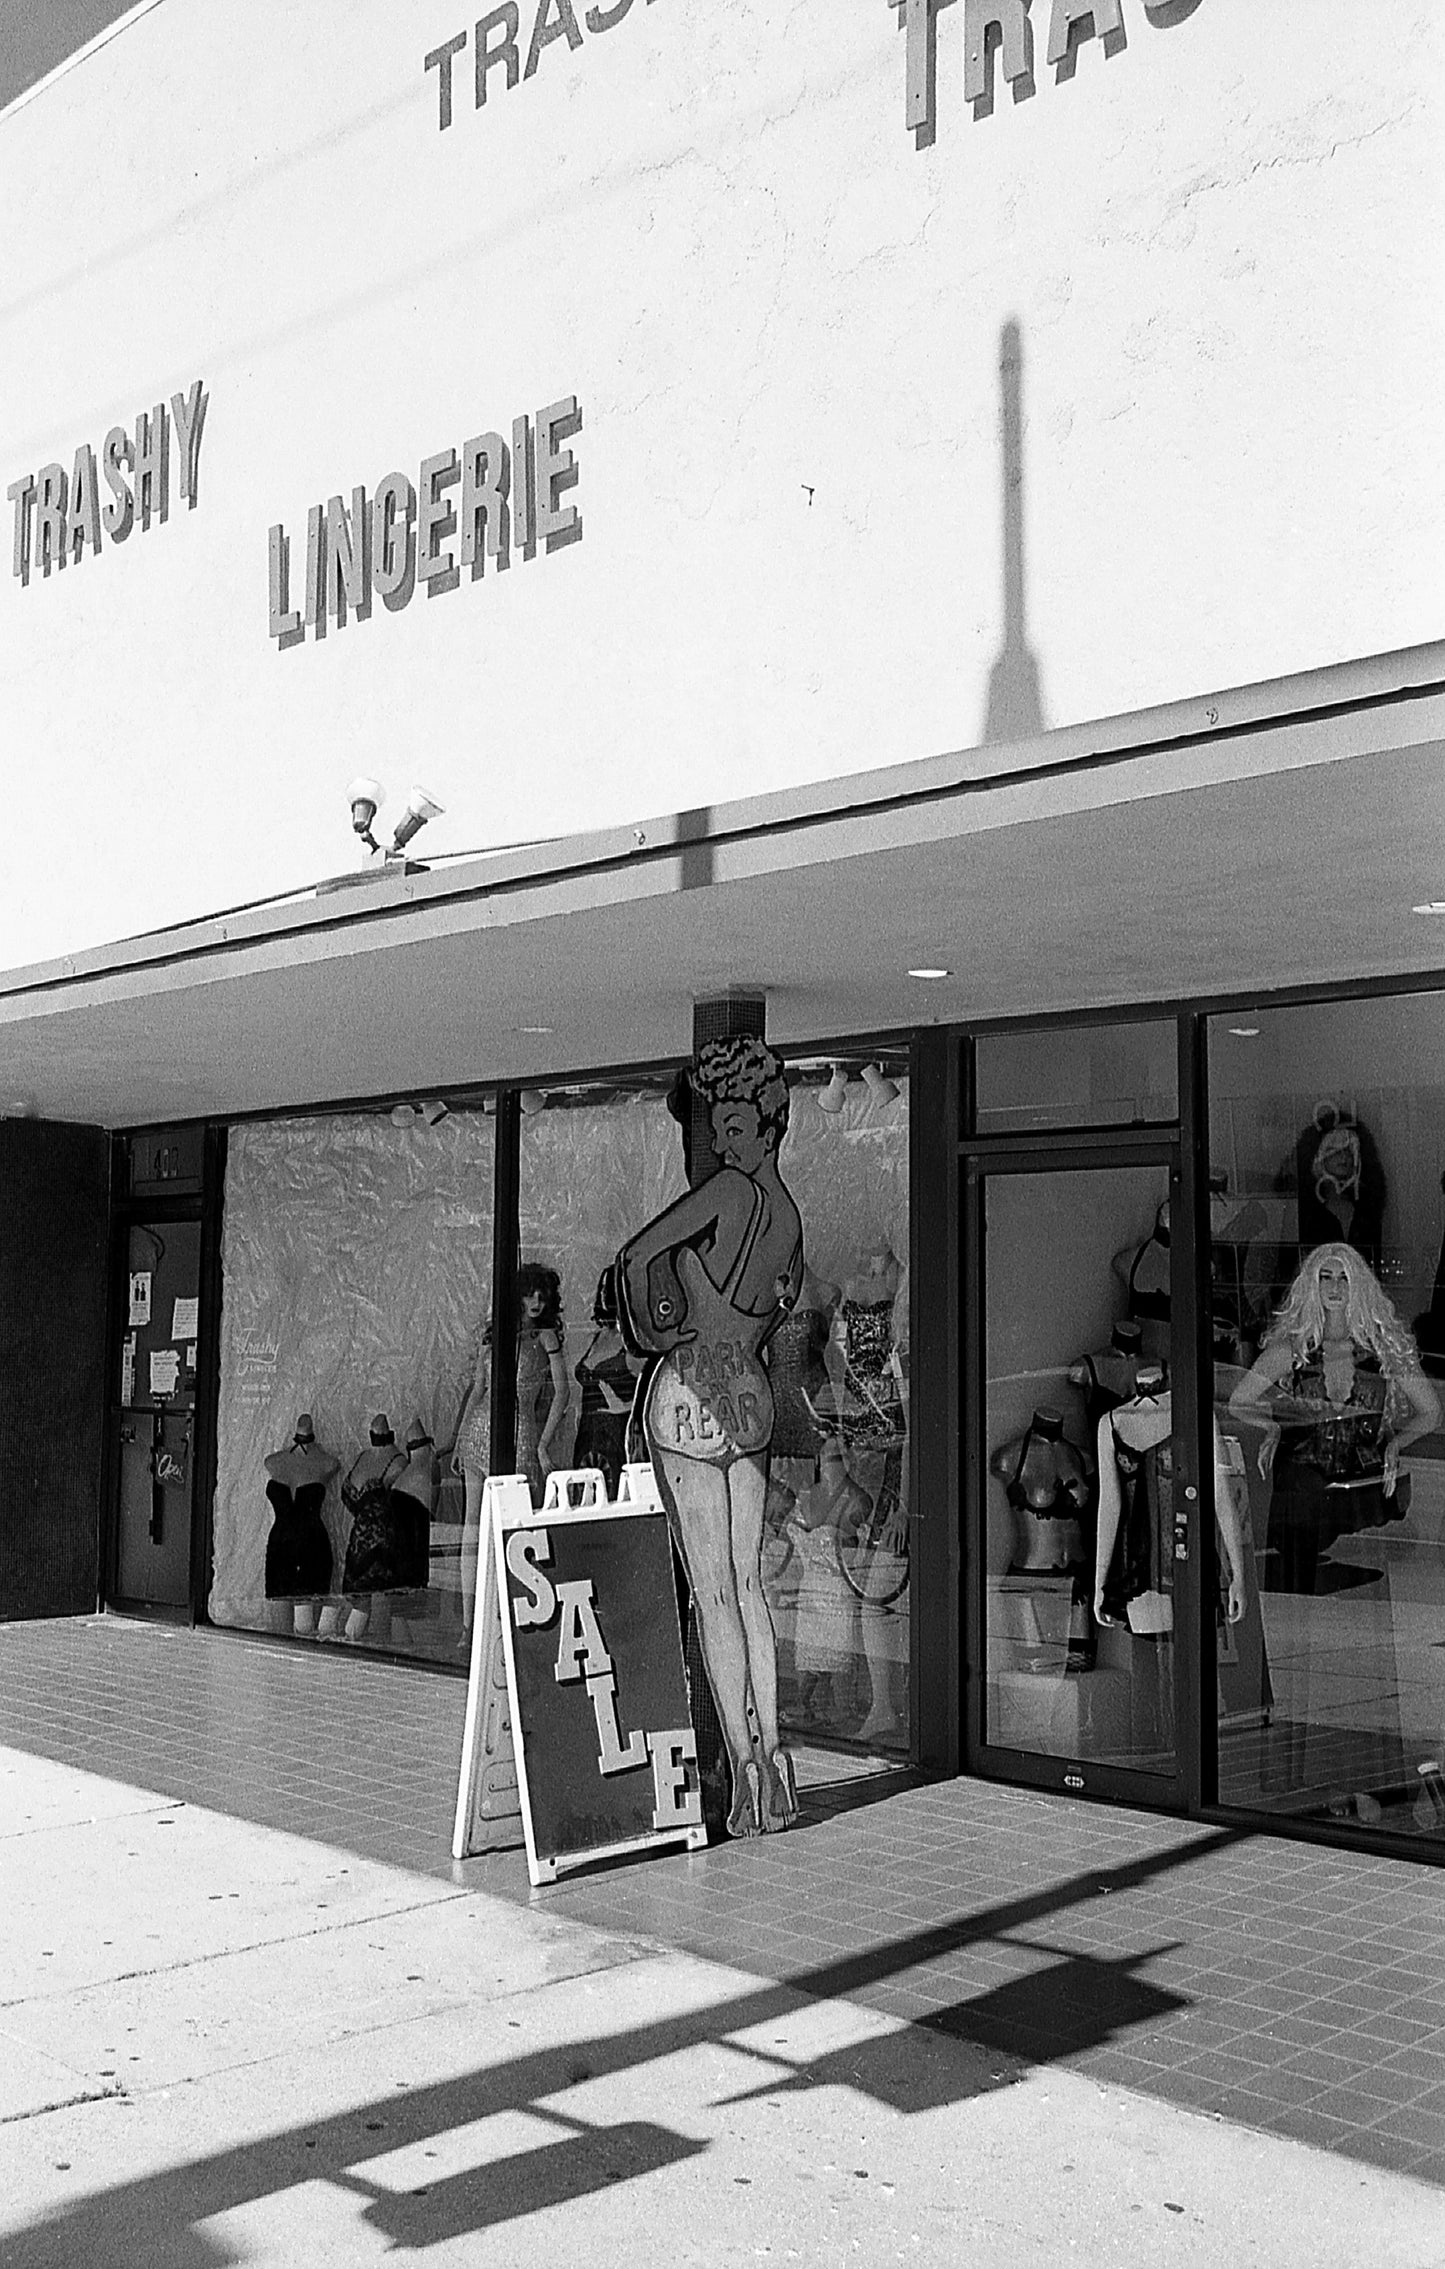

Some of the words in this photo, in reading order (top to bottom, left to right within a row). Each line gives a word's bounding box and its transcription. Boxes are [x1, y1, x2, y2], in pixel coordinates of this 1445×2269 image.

[8, 380, 206, 584] TRASHY
[268, 396, 581, 646] LINGERIE
[673, 1340, 756, 1385] PARK
[675, 1391, 763, 1442] REAR
[506, 1529, 702, 1829] SALE
